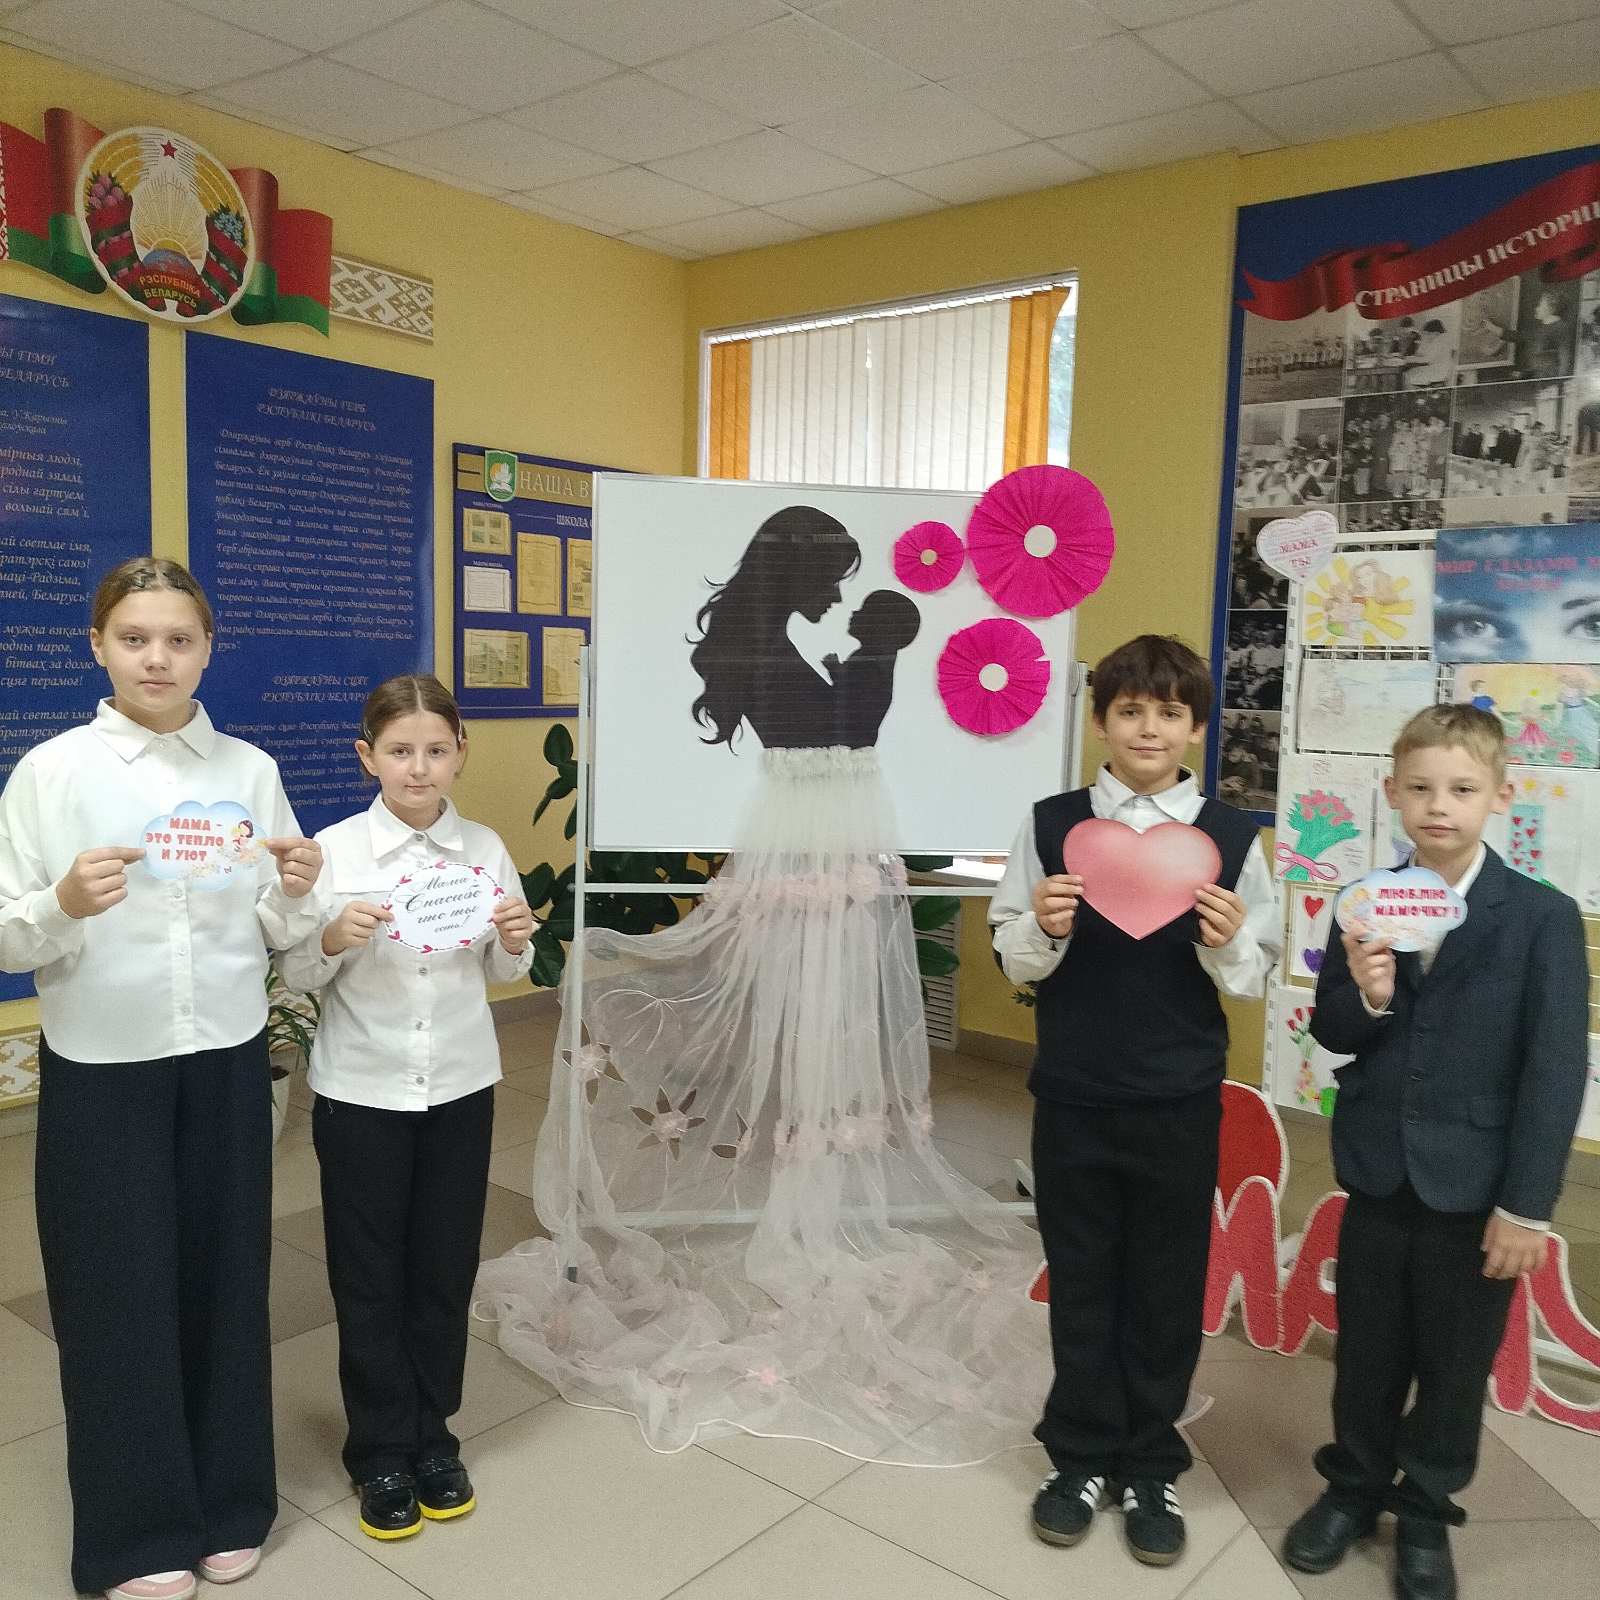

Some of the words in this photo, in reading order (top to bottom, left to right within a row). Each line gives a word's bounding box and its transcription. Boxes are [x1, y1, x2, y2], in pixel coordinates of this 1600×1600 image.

[140, 274, 200, 298] РЭСПУБЛІКА
[1354, 254, 1485, 307] СТРАНИЦЫ
[144, 288, 197, 308] БЕЛАРУСЬ
[519, 471, 575, 496] НАША
[556, 514, 590, 529] ШКОЛА
[169, 817, 210, 831] МАМА
[145, 832, 172, 844] ЭТО
[177, 834, 224, 847] ТЕПЛО
[161, 848, 170, 860] И
[175, 849, 207, 862] УЮТ
[1377, 888, 1447, 900] ЛЮБЛЮ
[416, 911, 447, 925] что
